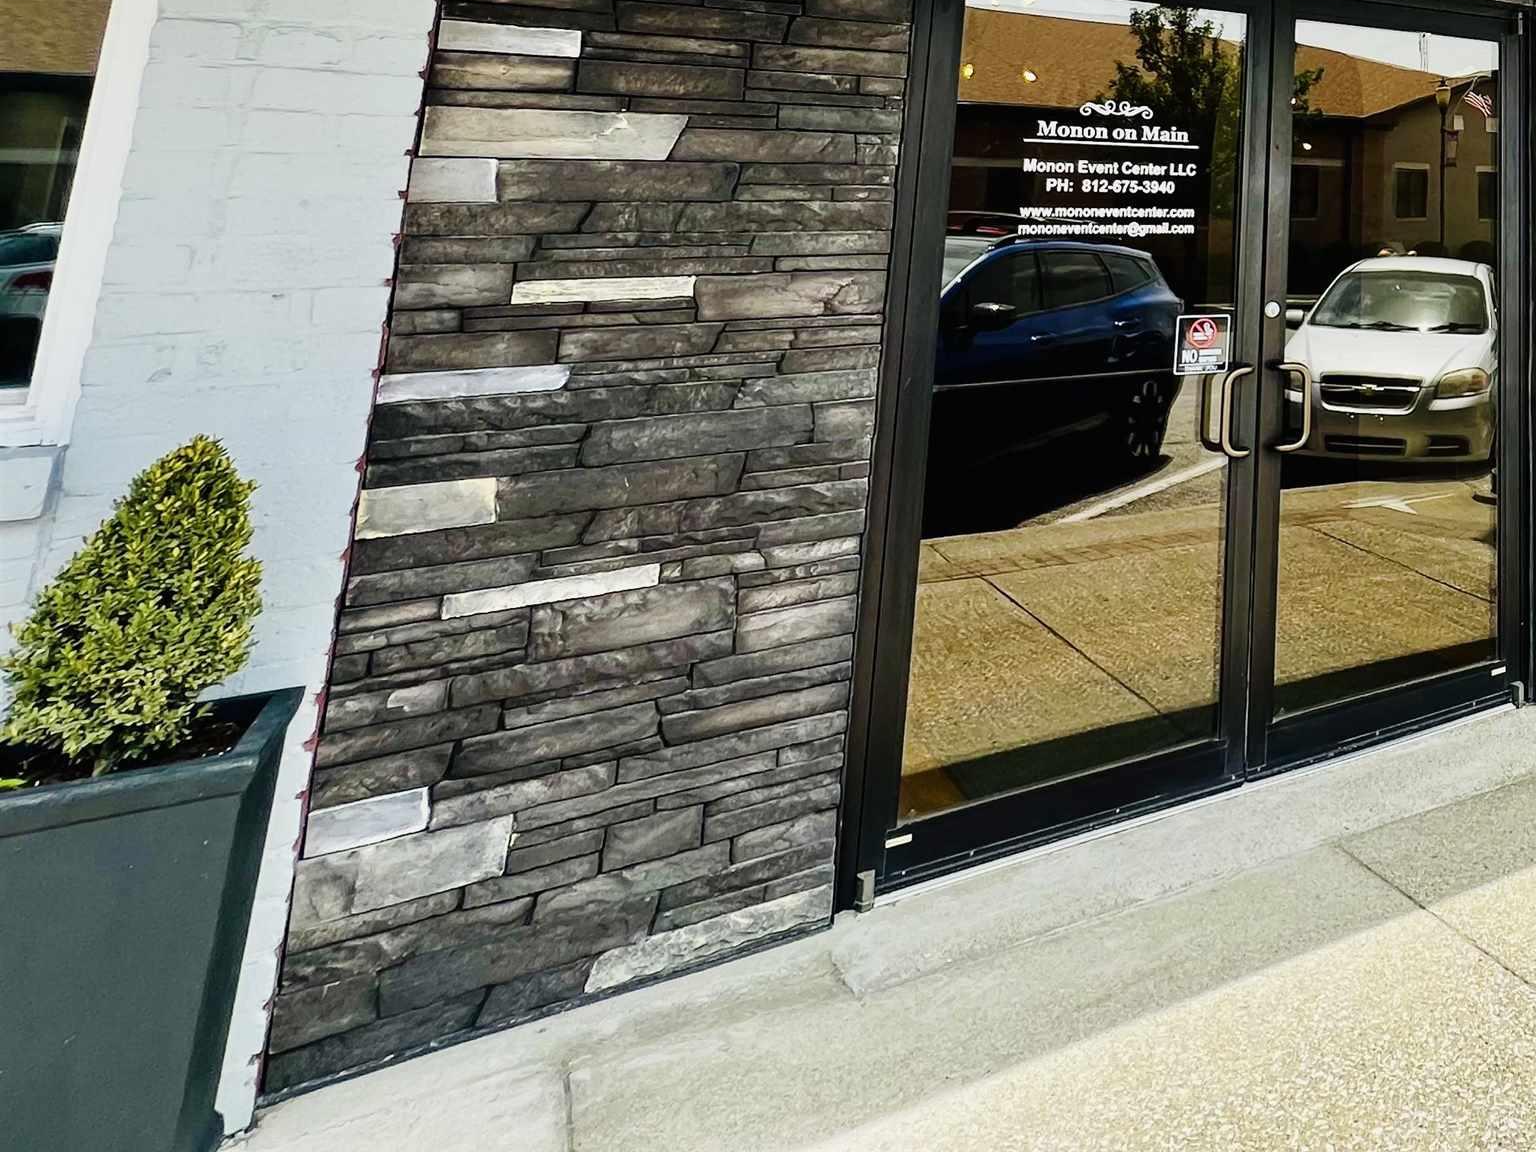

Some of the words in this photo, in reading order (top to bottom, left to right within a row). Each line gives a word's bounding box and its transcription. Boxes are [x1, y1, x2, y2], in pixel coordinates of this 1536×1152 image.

[1037, 120, 1109, 140] Monon
[1112, 128, 1138, 141] on
[1141, 125, 1189, 144] Main
[1023, 158, 1075, 174] Monon
[1077, 159, 1119, 175] Event
[1121, 161, 1168, 177] Center
[1169, 163, 1197, 177] LLC
[1045, 178, 1074, 193] PH:
[1081, 179, 1176, 194] 812-675-3940
[1019, 205, 1195, 219] www.mononeventcenter.com
[1017, 221, 1195, 237] mononeventcenter@gmail.com
[1181, 349, 1199, 364] NO
